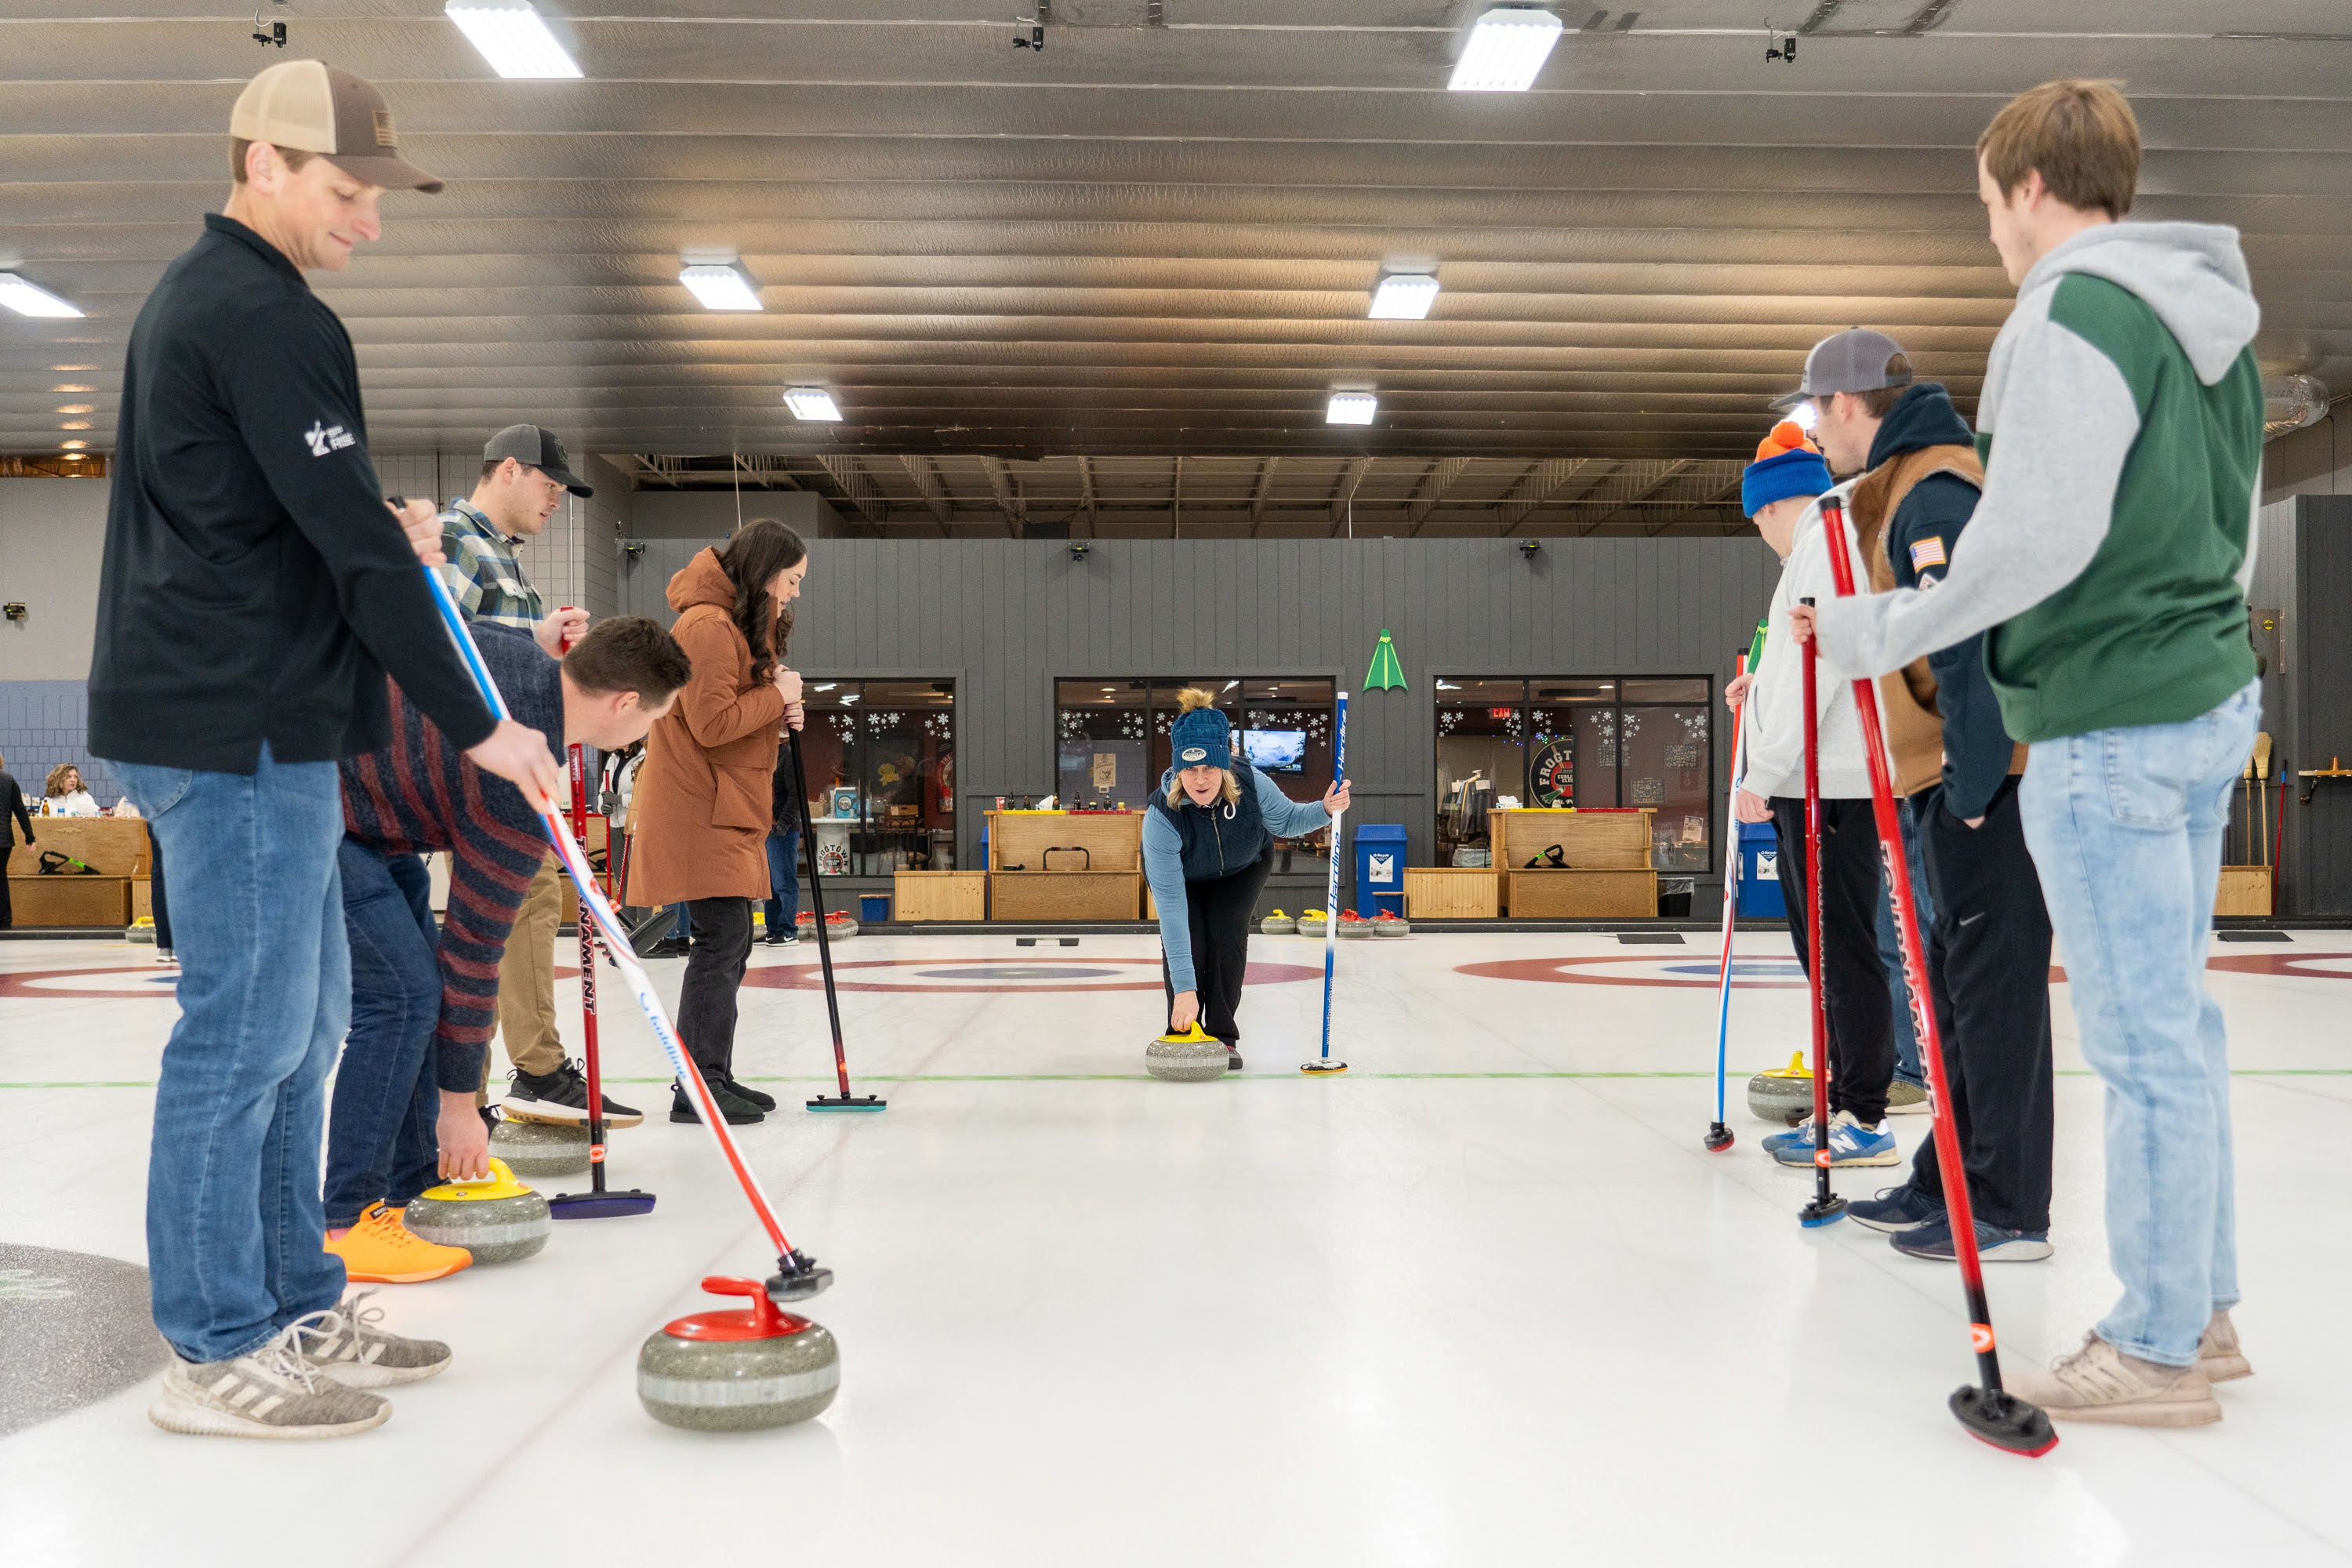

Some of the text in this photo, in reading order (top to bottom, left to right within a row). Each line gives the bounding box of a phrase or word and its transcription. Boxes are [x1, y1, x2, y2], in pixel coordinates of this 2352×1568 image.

[1337, 709, 1348, 771] Hardline
[818, 844, 848, 866] FROGTOWN
[1329, 832, 1340, 911] Hardline
